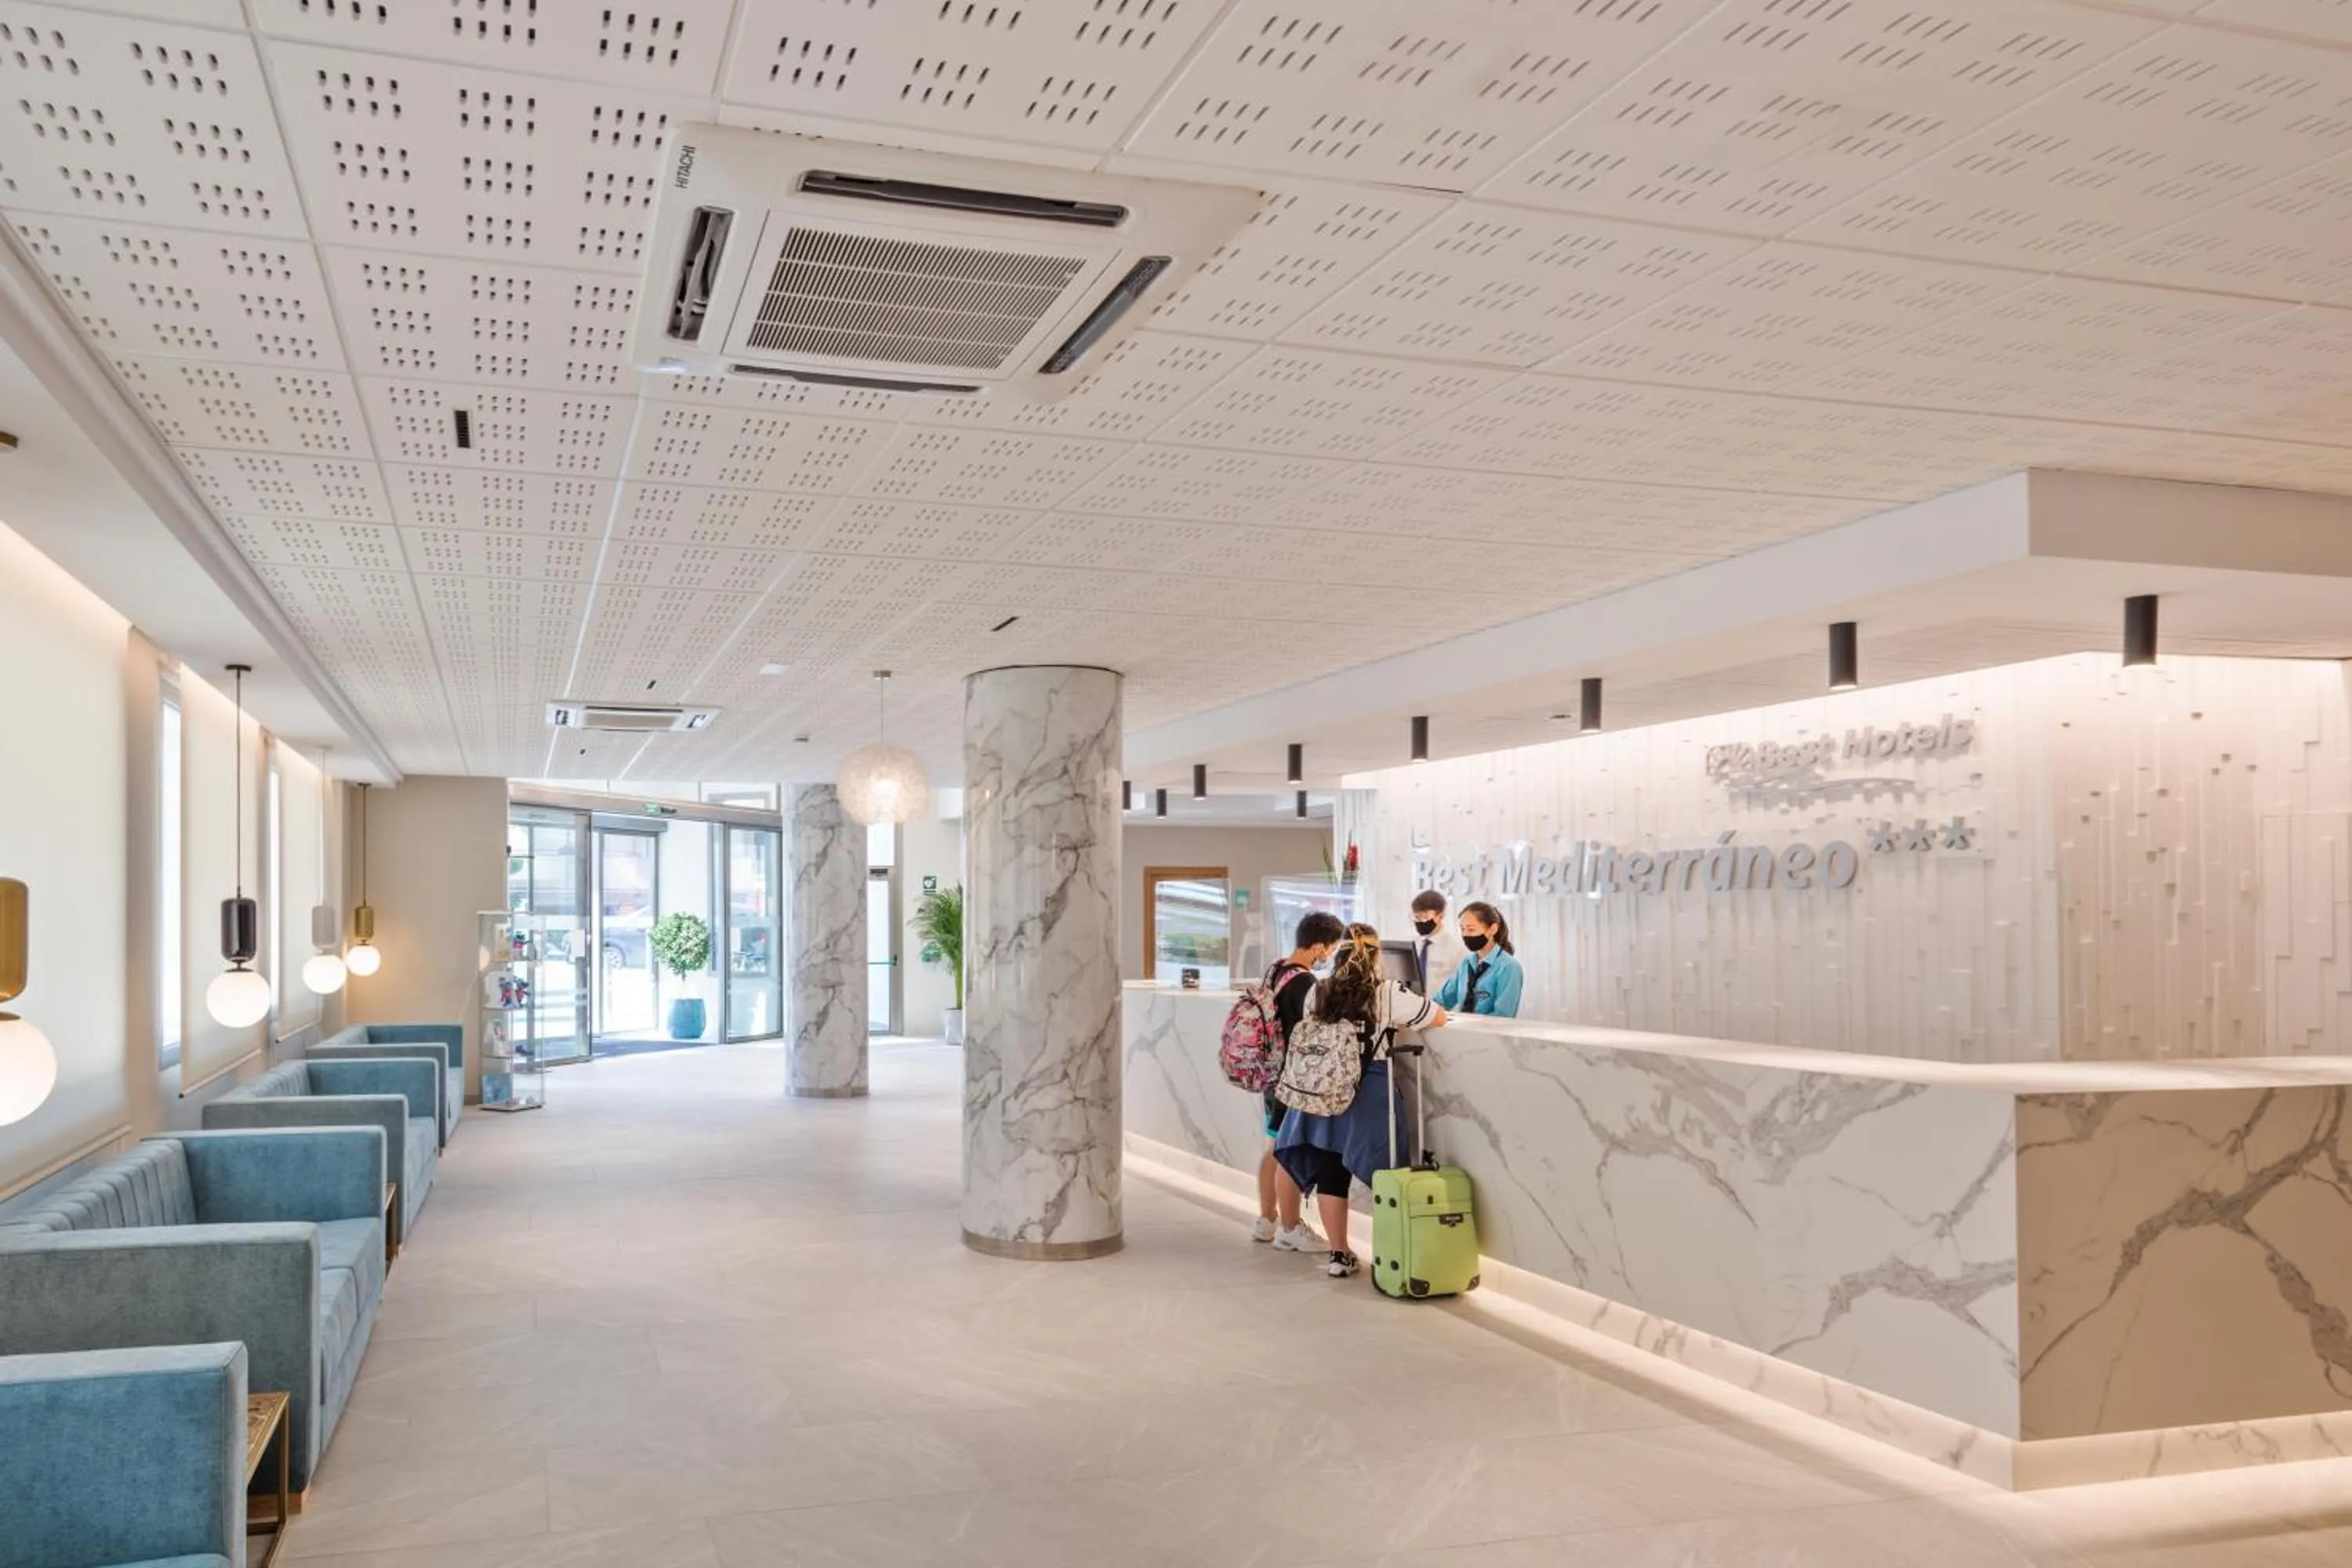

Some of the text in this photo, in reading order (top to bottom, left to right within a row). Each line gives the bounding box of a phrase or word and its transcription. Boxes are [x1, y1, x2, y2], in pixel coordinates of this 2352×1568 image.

[675, 145, 696, 189] HITACHI
[1756, 713, 1976, 770] Best Hotels
[1411, 829, 1859, 897] Best Mediterráneo
